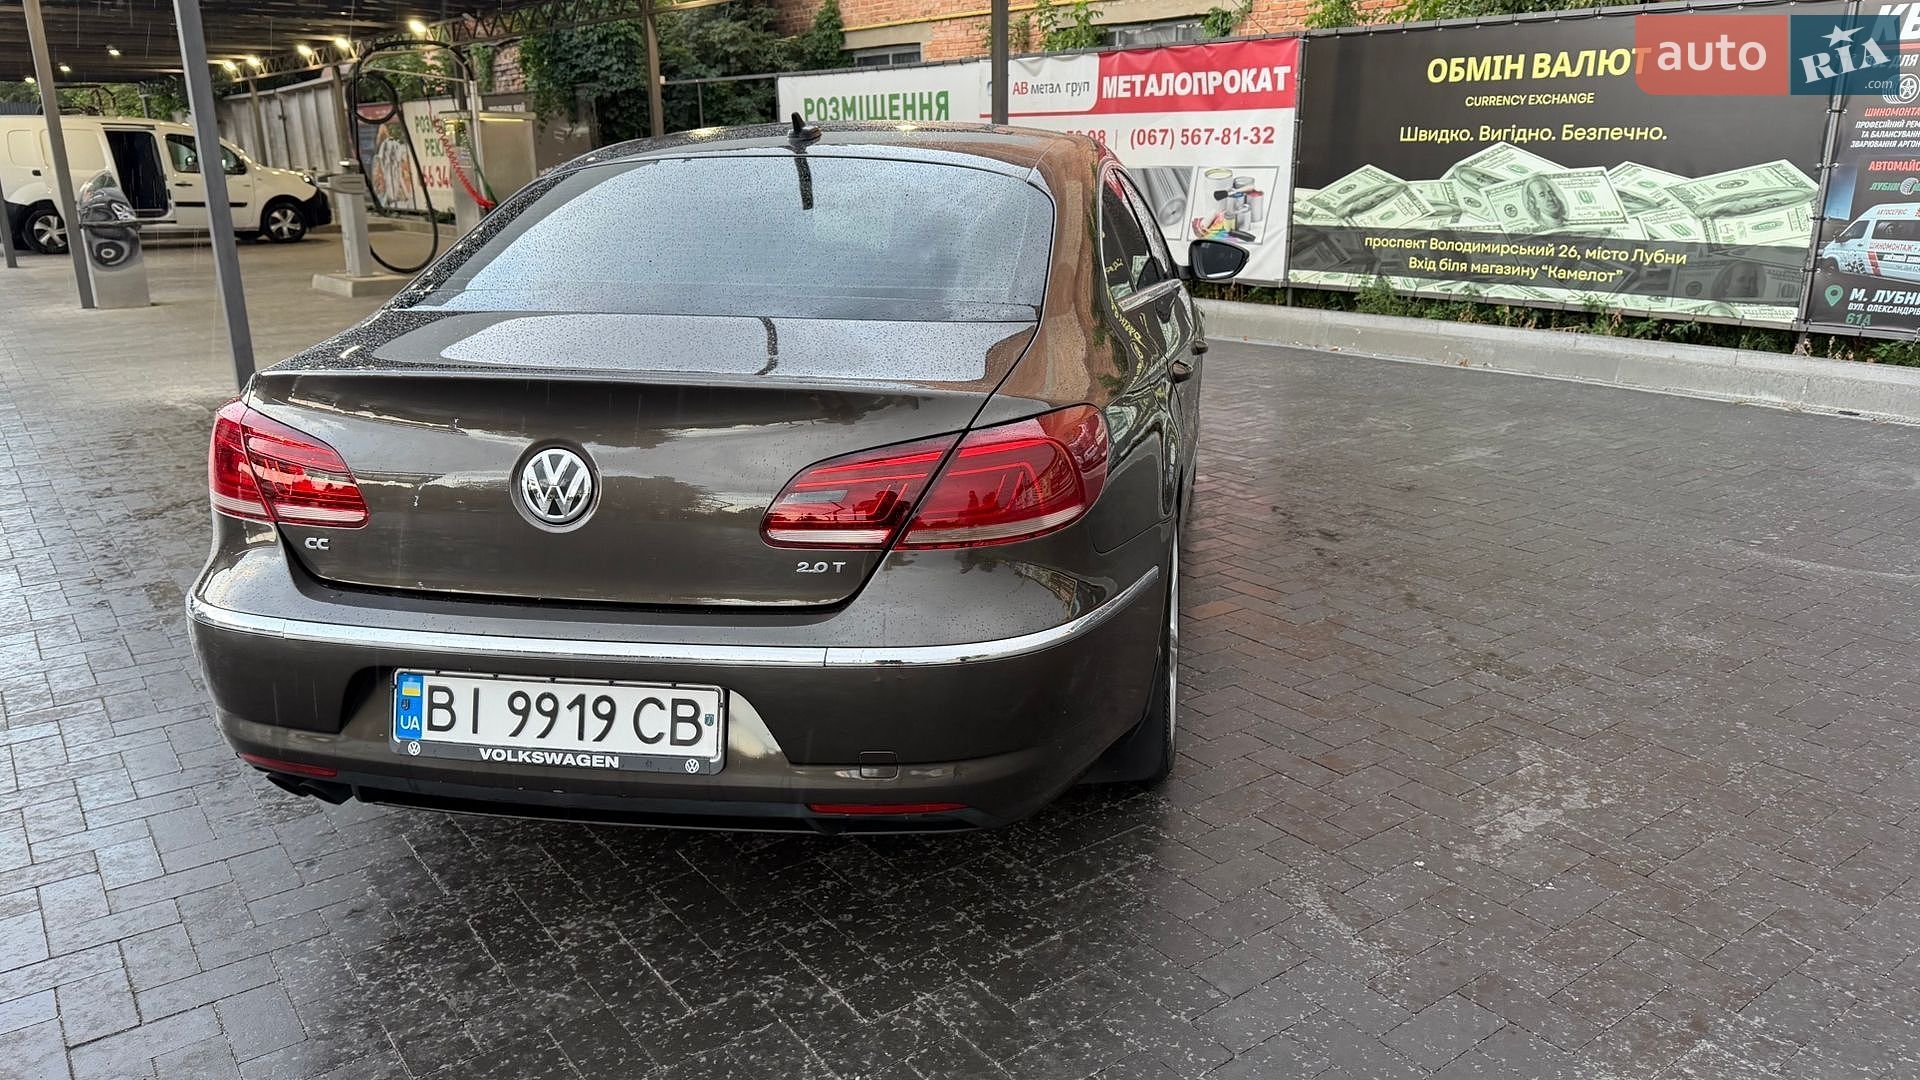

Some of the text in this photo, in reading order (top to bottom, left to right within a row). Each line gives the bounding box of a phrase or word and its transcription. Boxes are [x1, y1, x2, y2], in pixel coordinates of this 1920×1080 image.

[1427, 47, 1652, 84] ОБМІН ВАЛЮТ
[1030, 83, 1061, 94] метал
[1066, 81, 1090, 96] груп
[1102, 66, 1291, 98] МЕТАЛОПРОКАТ
[803, 90, 950, 121] РОЗМІЩЕННЯ
[1465, 92, 1595, 107] CURRENCY EXCHANGE
[1130, 128, 1175, 149] (067)
[1181, 126, 1275, 146] 567-81-32
[1400, 123, 1668, 144] Швидко. Вигідно. Безпечно.
[1364, 236, 1688, 266] проспект Володимирський 26, місто Лубни
[1408, 256, 1624, 283] Вхід біля магазину “Камелот”
[1849, 288, 1868, 302] М.
[304, 537, 330, 550] CC
[796, 561, 846, 573] 2.0 T
[401, 715, 420, 731] UA
[507, 690, 617, 742] 9919
[633, 696, 703, 747] CB
[479, 748, 619, 769] VOLKSWAGEN
